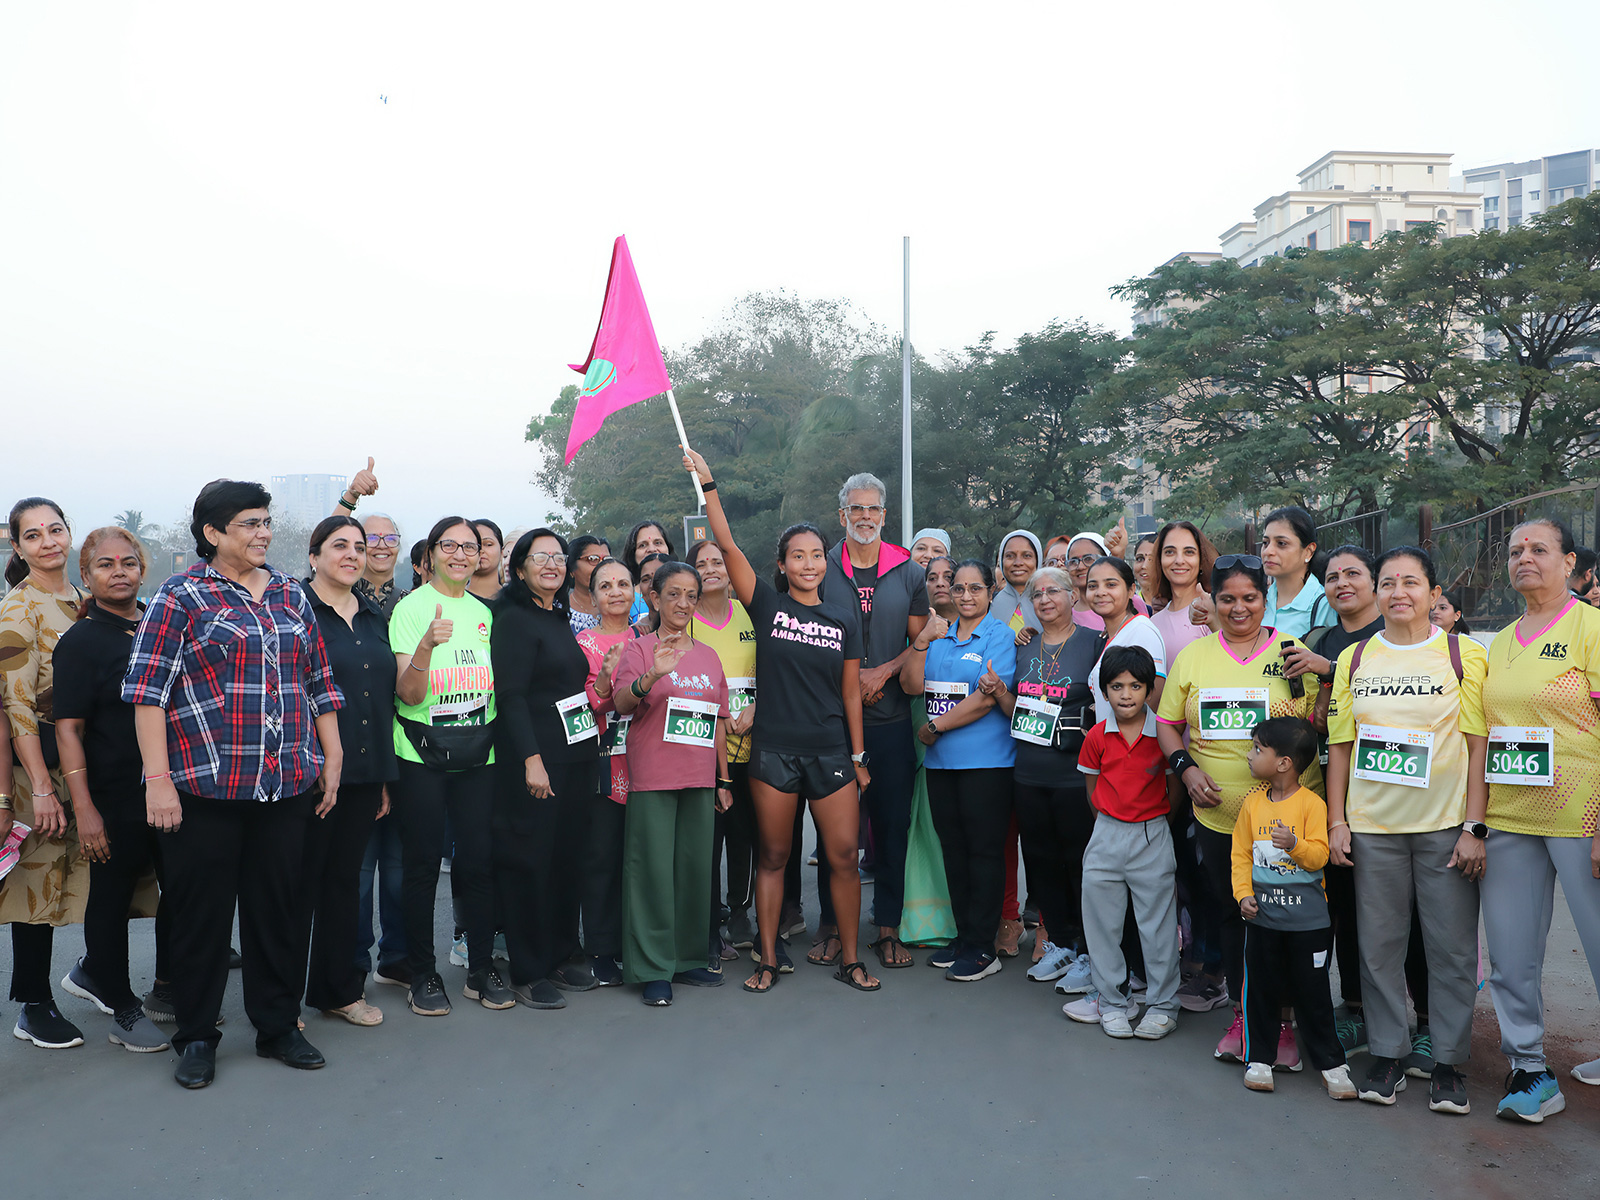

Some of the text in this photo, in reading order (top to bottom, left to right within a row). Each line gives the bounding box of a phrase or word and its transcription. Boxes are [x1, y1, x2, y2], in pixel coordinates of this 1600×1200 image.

[770, 628, 842, 651] AMBASSADOR
[461, 650, 477, 665] AM
[430, 665, 494, 696] INVINCIBL
[1354, 676, 1431, 686] SKECHERS
[1226, 701, 1240, 709] 5K
[674, 718, 711, 738] 5009
[1015, 716, 1047, 736] 5049
[1209, 710, 1258, 729] 5032
[1384, 742, 1401, 752] 5K
[1505, 742, 1520, 751] 5K
[1364, 750, 1419, 775] 5026
[1491, 753, 1540, 774] 5046
